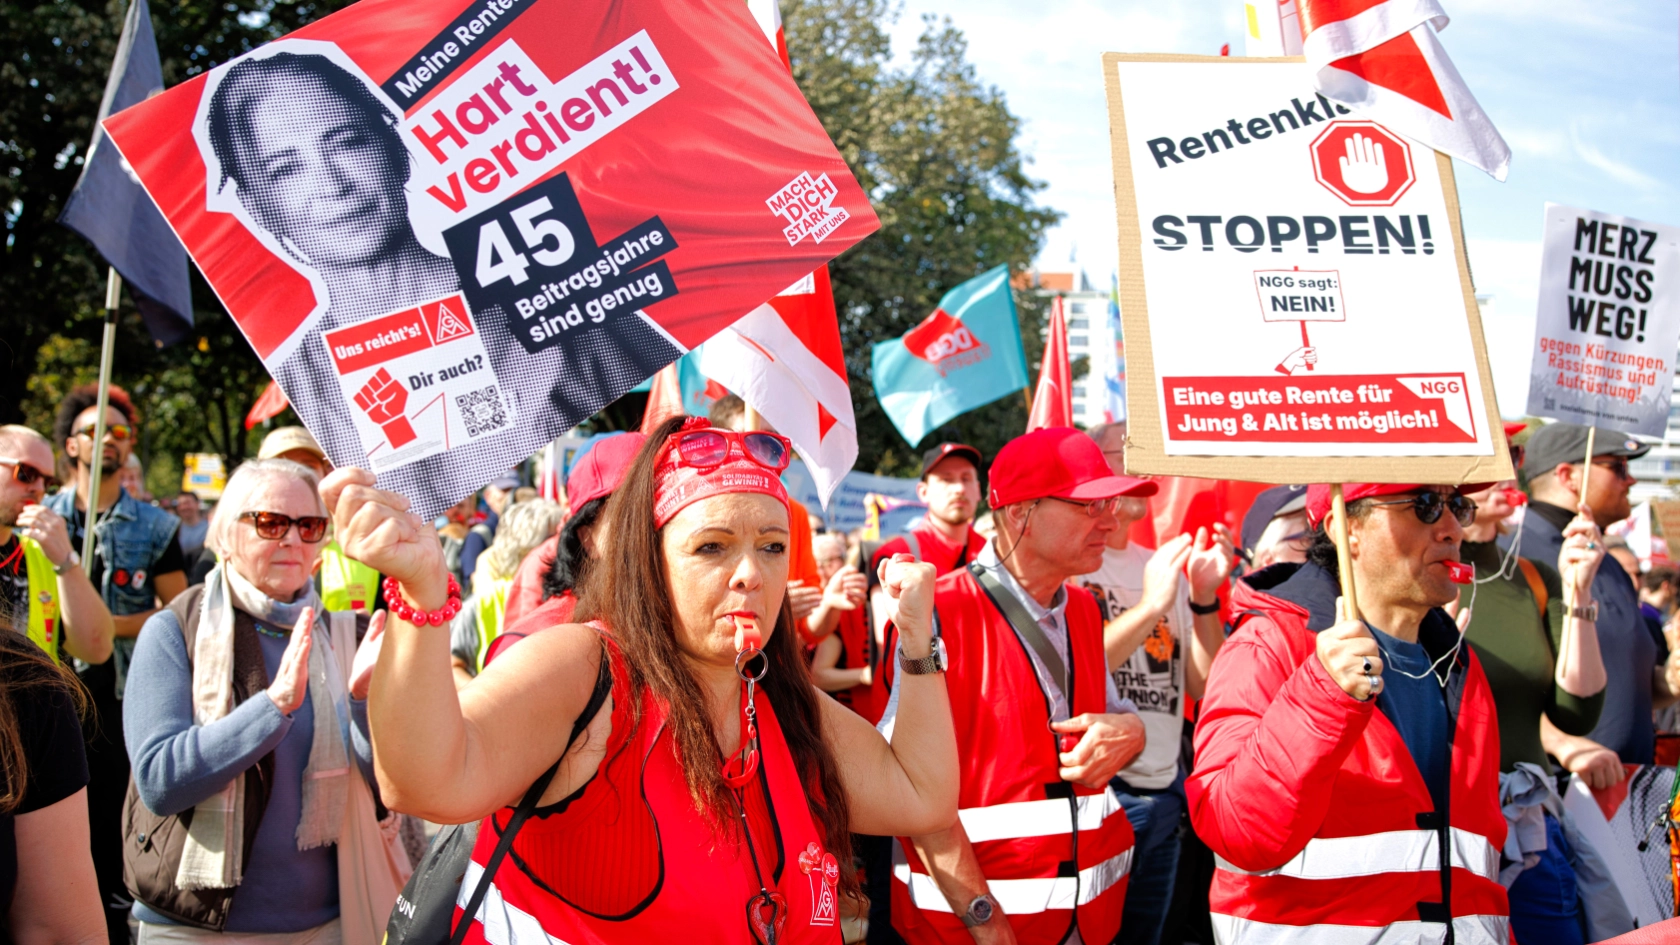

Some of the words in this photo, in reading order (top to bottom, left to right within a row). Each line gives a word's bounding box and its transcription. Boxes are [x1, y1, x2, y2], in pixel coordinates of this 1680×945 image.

[394, 41, 460, 98] Meine
[411, 61, 538, 165] Hart
[425, 45, 661, 214] verdient!
[769, 175, 812, 212] MACH
[785, 178, 834, 222] DICH
[787, 204, 830, 242] STARK
[814, 223, 830, 240] MIT
[828, 211, 846, 228] UNS
[1151, 214, 1435, 255] STOPPEN!
[1574, 217, 1658, 265] MERZ
[474, 195, 576, 289] 45
[514, 229, 664, 320] Beitragsjahre
[1259, 276, 1295, 288] NGG
[1298, 277, 1338, 291] sagt:
[1568, 256, 1654, 304] MUSS
[529, 302, 585, 343] sind
[585, 272, 664, 323] genug
[1270, 295, 1336, 313] NEIN!
[1567, 295, 1648, 343] WEG!
[334, 344, 364, 360] Uns
[1539, 336, 1581, 357] gegen
[1585, 343, 1667, 373] Kürzungen,
[1547, 352, 1623, 381] Rassismus
[1628, 369, 1656, 387] und
[408, 371, 434, 391] Dir
[438, 354, 484, 382] auch?
[1420, 381, 1459, 394] NGG
[1556, 371, 1642, 404] Aufrüstung!
[1172, 386, 1225, 406] Eine
[1228, 388, 1281, 411] gute
[1285, 386, 1354, 405] Rente
[1355, 384, 1394, 403] für
[1177, 414, 1238, 437] Jung
[1242, 413, 1258, 432] &
[1263, 411, 1299, 431] Alt
[1301, 411, 1333, 431] ist
[1336, 409, 1439, 434] möglich!
[1118, 671, 1149, 687] THE
